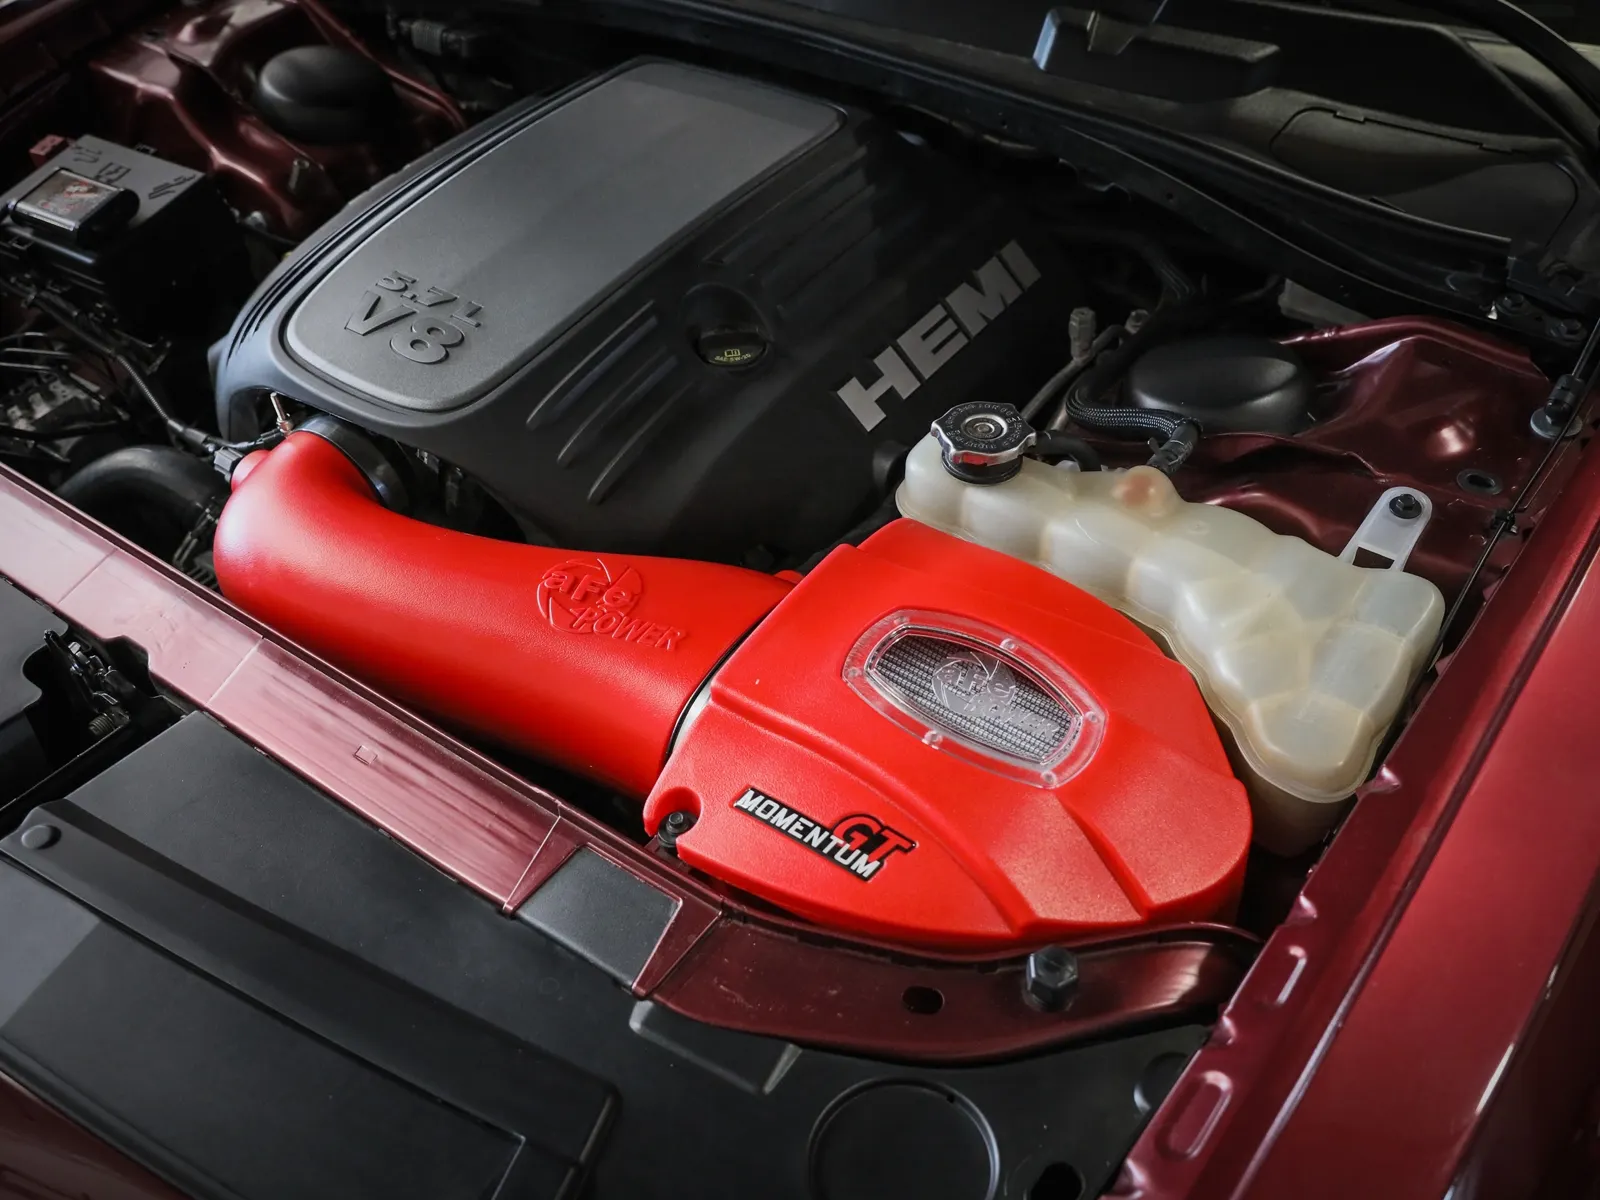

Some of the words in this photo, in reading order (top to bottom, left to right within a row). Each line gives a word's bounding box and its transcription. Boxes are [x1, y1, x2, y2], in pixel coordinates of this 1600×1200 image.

[344, 289, 466, 365] V8
[375, 270, 484, 328] 5.7L
[836, 239, 1042, 432] HEMI
[570, 606, 687, 651] POWER
[734, 788, 881, 878] MOMENTUM
[832, 815, 914, 863] GT
